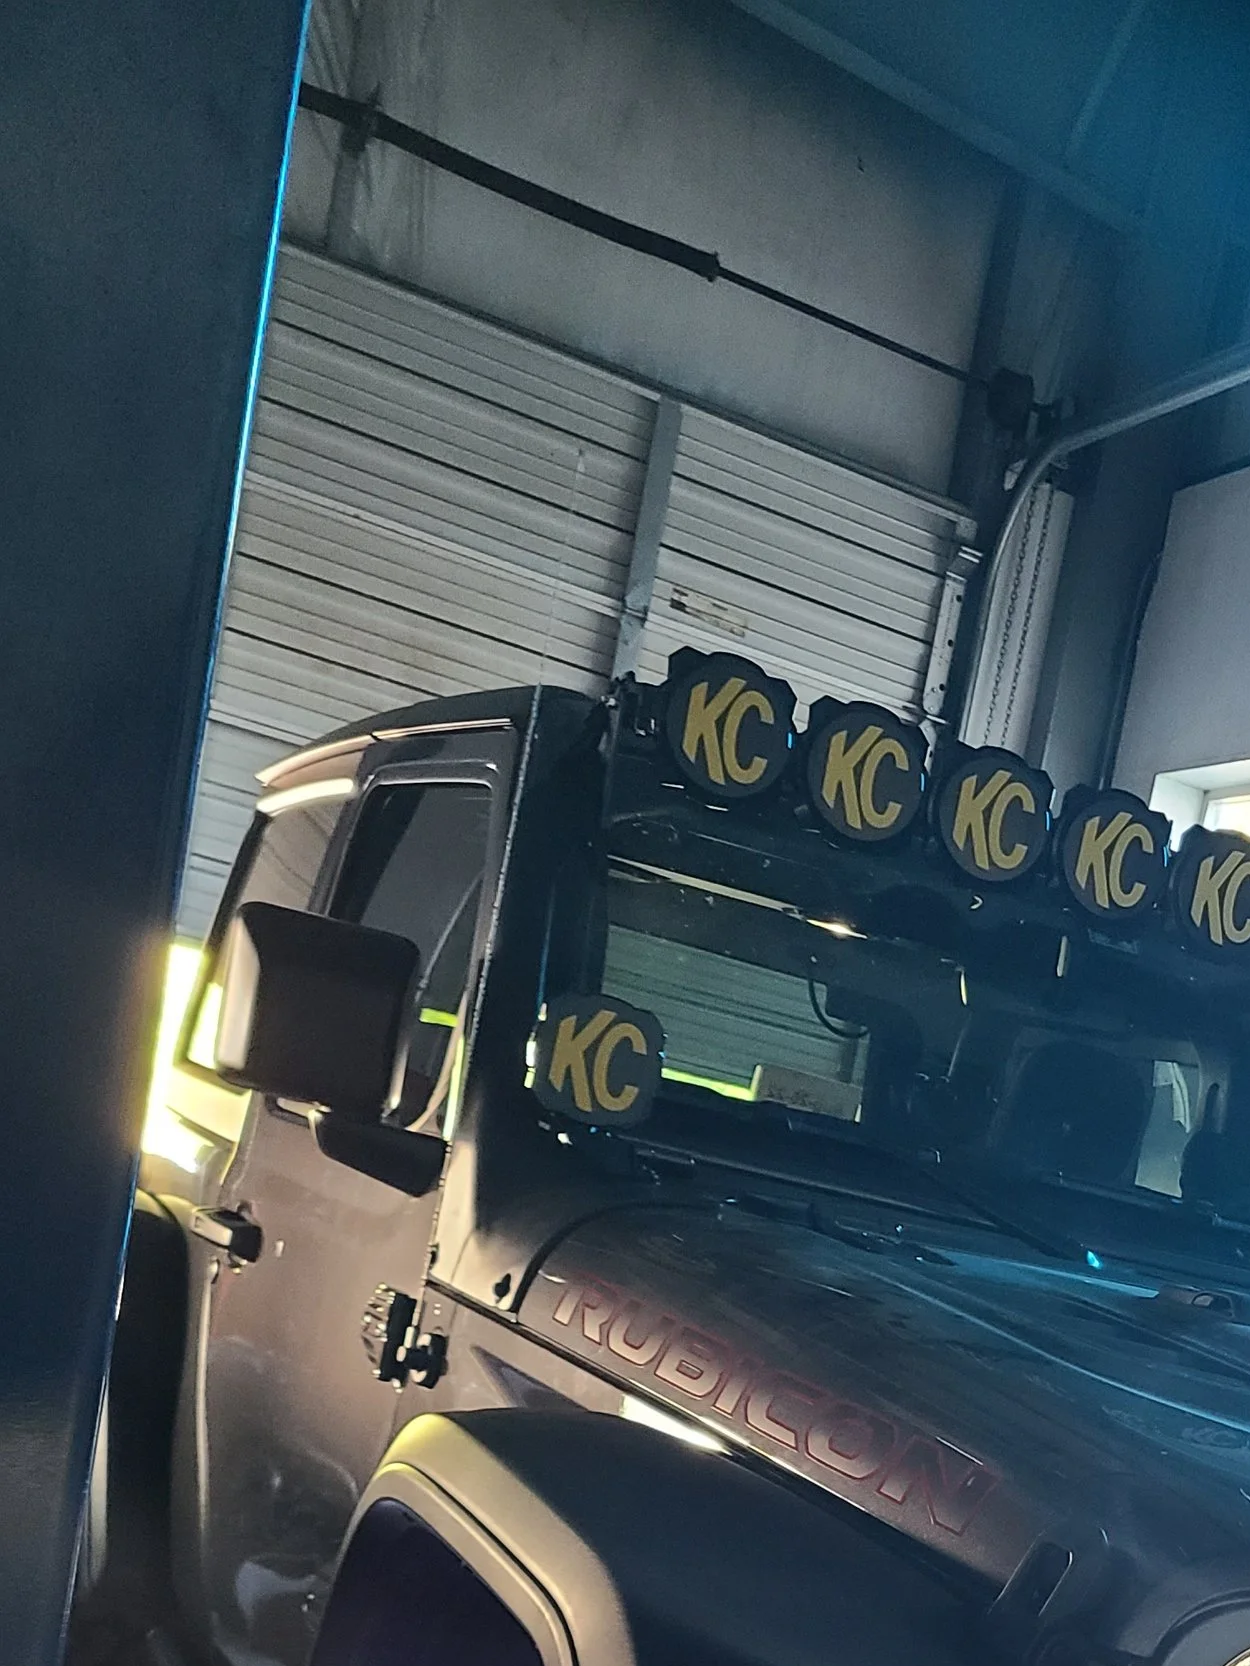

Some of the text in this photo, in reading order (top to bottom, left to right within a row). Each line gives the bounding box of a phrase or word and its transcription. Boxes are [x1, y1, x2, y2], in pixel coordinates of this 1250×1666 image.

[682, 677, 774, 785] KC
[821, 725, 908, 829] KC
[953, 769, 1036, 871] KC
[1076, 812, 1153, 909] KC
[549, 1010, 647, 1112] KC
[554, 1274, 998, 1536] RUBICON
